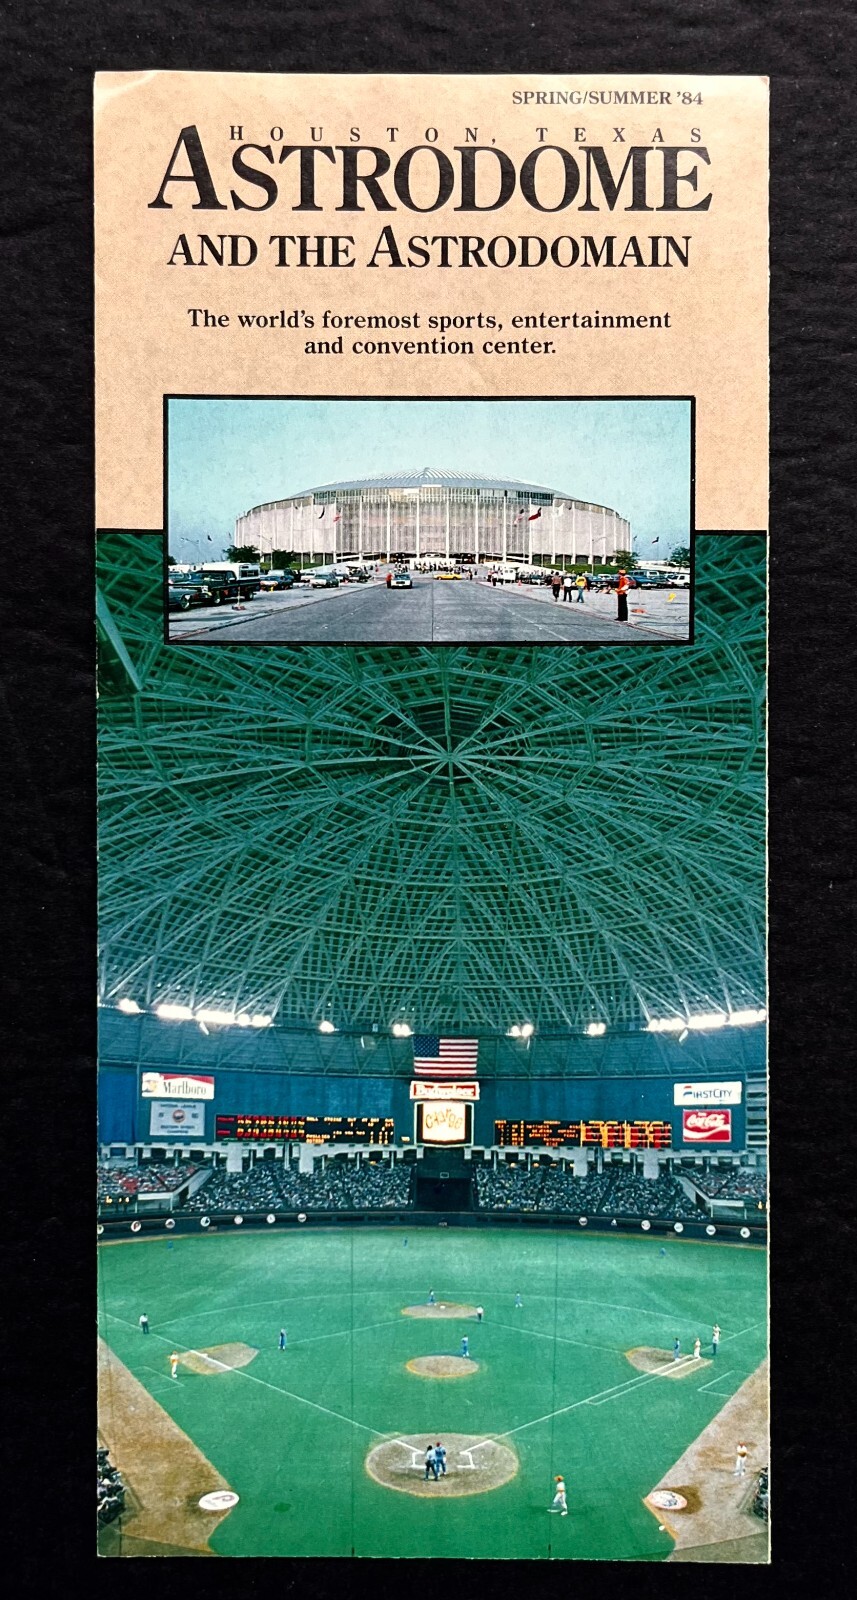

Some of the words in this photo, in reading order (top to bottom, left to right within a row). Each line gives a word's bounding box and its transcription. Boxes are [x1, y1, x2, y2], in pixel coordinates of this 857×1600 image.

[512, 91, 672, 104] SPRING/SUMMER
[676, 91, 704, 105] '84
[229, 125, 496, 144] HOUSTON,
[535, 127, 702, 143] TEXAS
[148, 125, 713, 213] ASTRODOME
[167, 234, 258, 267] AND
[269, 235, 356, 268] THE
[366, 225, 692, 268] ASTRODOMAIN
[187, 309, 230, 328] The
[237, 309, 315, 329] world's
[322, 310, 421, 329] foremost
[428, 312, 503, 333] sports,
[511, 311, 672, 329] entertainment
[304, 336, 344, 355] and
[352, 336, 475, 355] convention
[482, 338, 557, 355] center.
[163, 1080, 207, 1095] Marlboro
